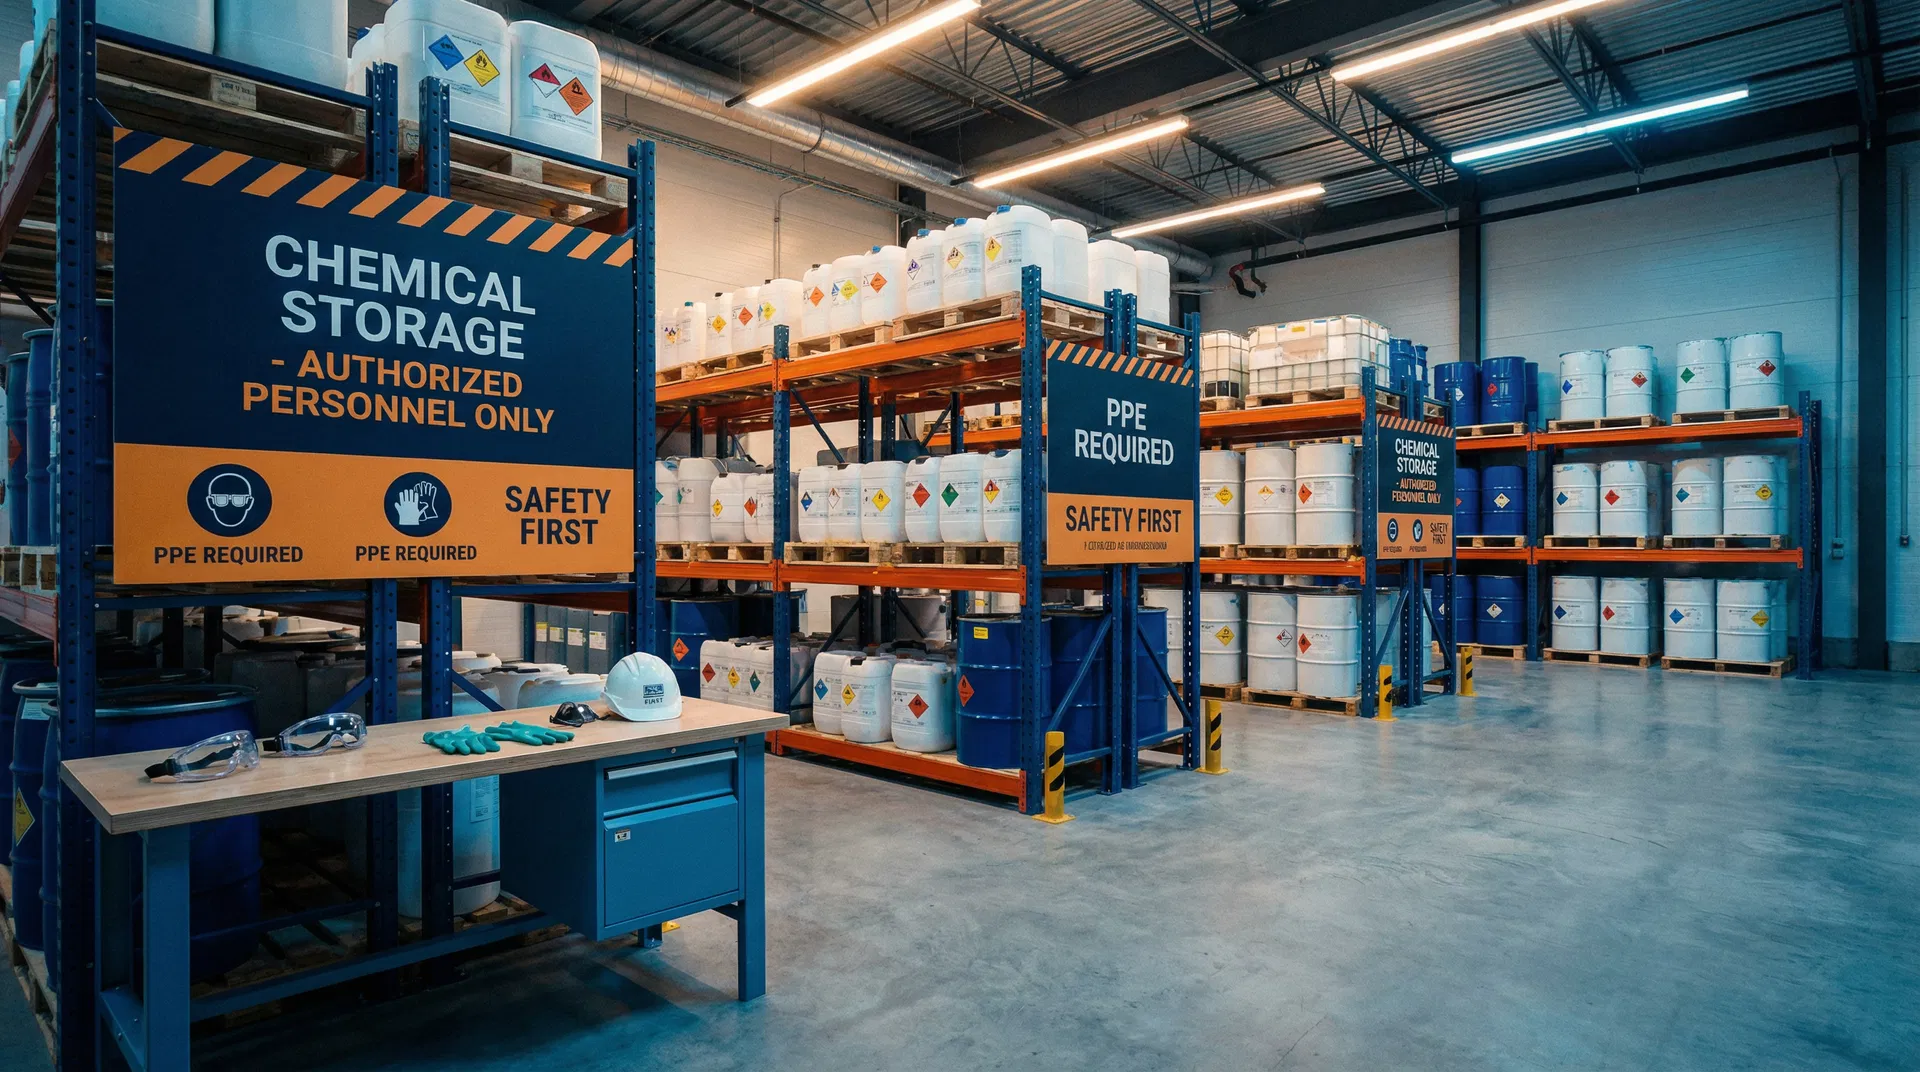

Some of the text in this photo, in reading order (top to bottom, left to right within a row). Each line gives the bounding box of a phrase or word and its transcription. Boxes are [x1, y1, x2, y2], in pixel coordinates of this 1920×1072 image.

[265, 234, 536, 315] CHEMICAL
[281, 290, 524, 360] STORAGE
[297, 349, 523, 398] AUTHORIZED
[243, 381, 555, 434] PERSONNEL ONLY
[1107, 397, 1147, 431] PPE
[1074, 428, 1174, 466] REQUIRED
[1395, 437, 1440, 459] CHEMICAL
[1396, 456, 1437, 476] STORAGE
[505, 485, 612, 514] SAFETY
[520, 518, 599, 545] FIRST
[1065, 504, 1182, 533] SAFETY FIRST
[154, 546, 304, 566] PPE REQUIRED
[355, 545, 477, 563] PPE REQUIRED
